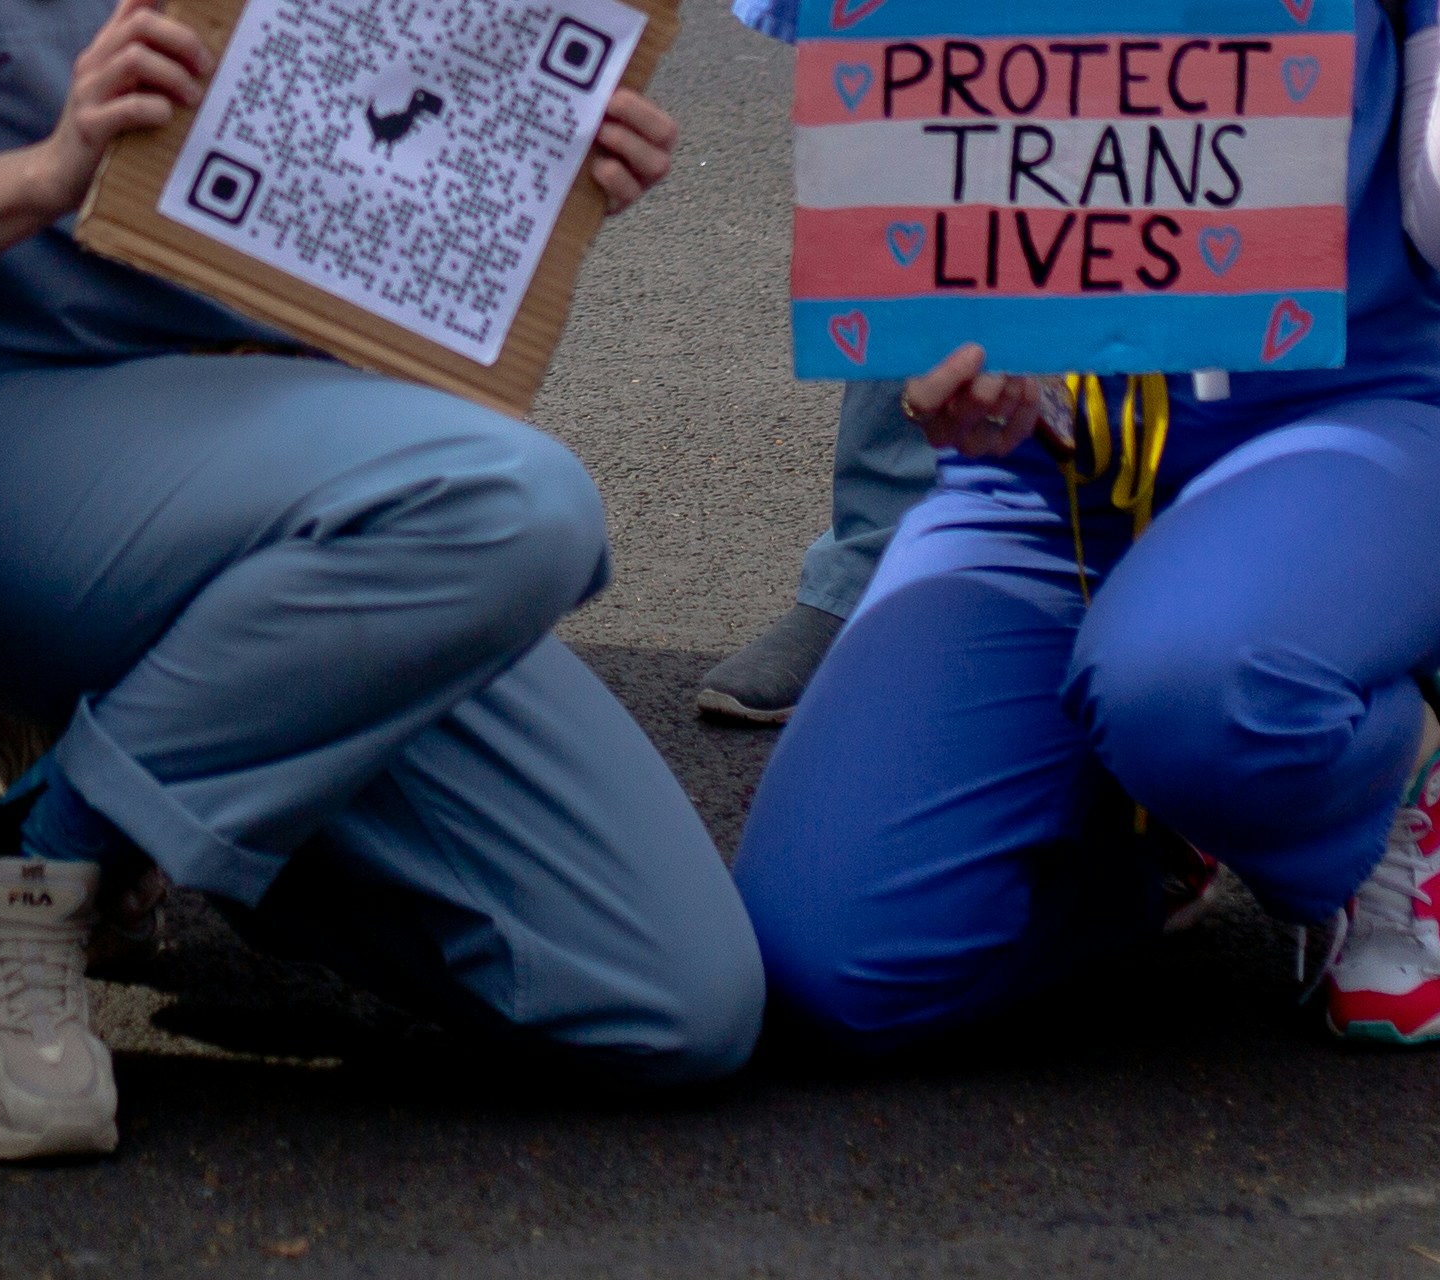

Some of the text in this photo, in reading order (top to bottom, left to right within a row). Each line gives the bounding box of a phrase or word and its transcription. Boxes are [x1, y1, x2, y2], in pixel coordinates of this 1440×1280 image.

[880, 39, 1273, 119] PROTECT
[923, 123, 1247, 207] TRANS
[933, 209, 1183, 293] LIVES
[9, 891, 54, 907] FILA
